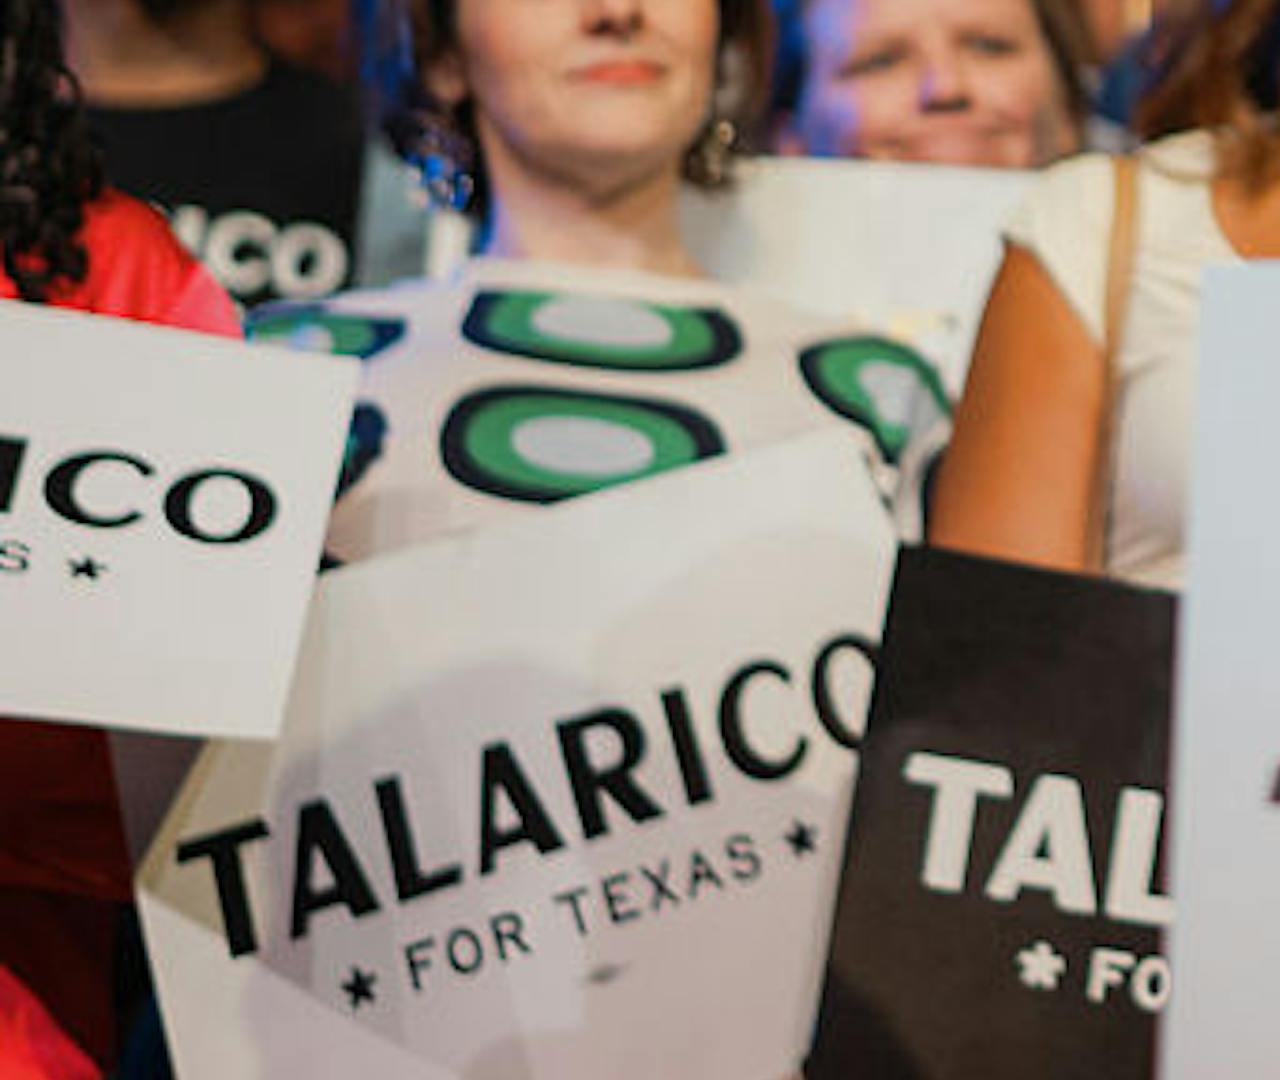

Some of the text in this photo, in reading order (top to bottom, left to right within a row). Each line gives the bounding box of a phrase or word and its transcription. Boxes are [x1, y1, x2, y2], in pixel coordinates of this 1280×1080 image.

[173, 632, 878, 959] TALARICO
[903, 751, 1174, 924] TAL
[404, 834, 763, 991] FOR TEXAS
[1087, 946, 1171, 1012] FO
